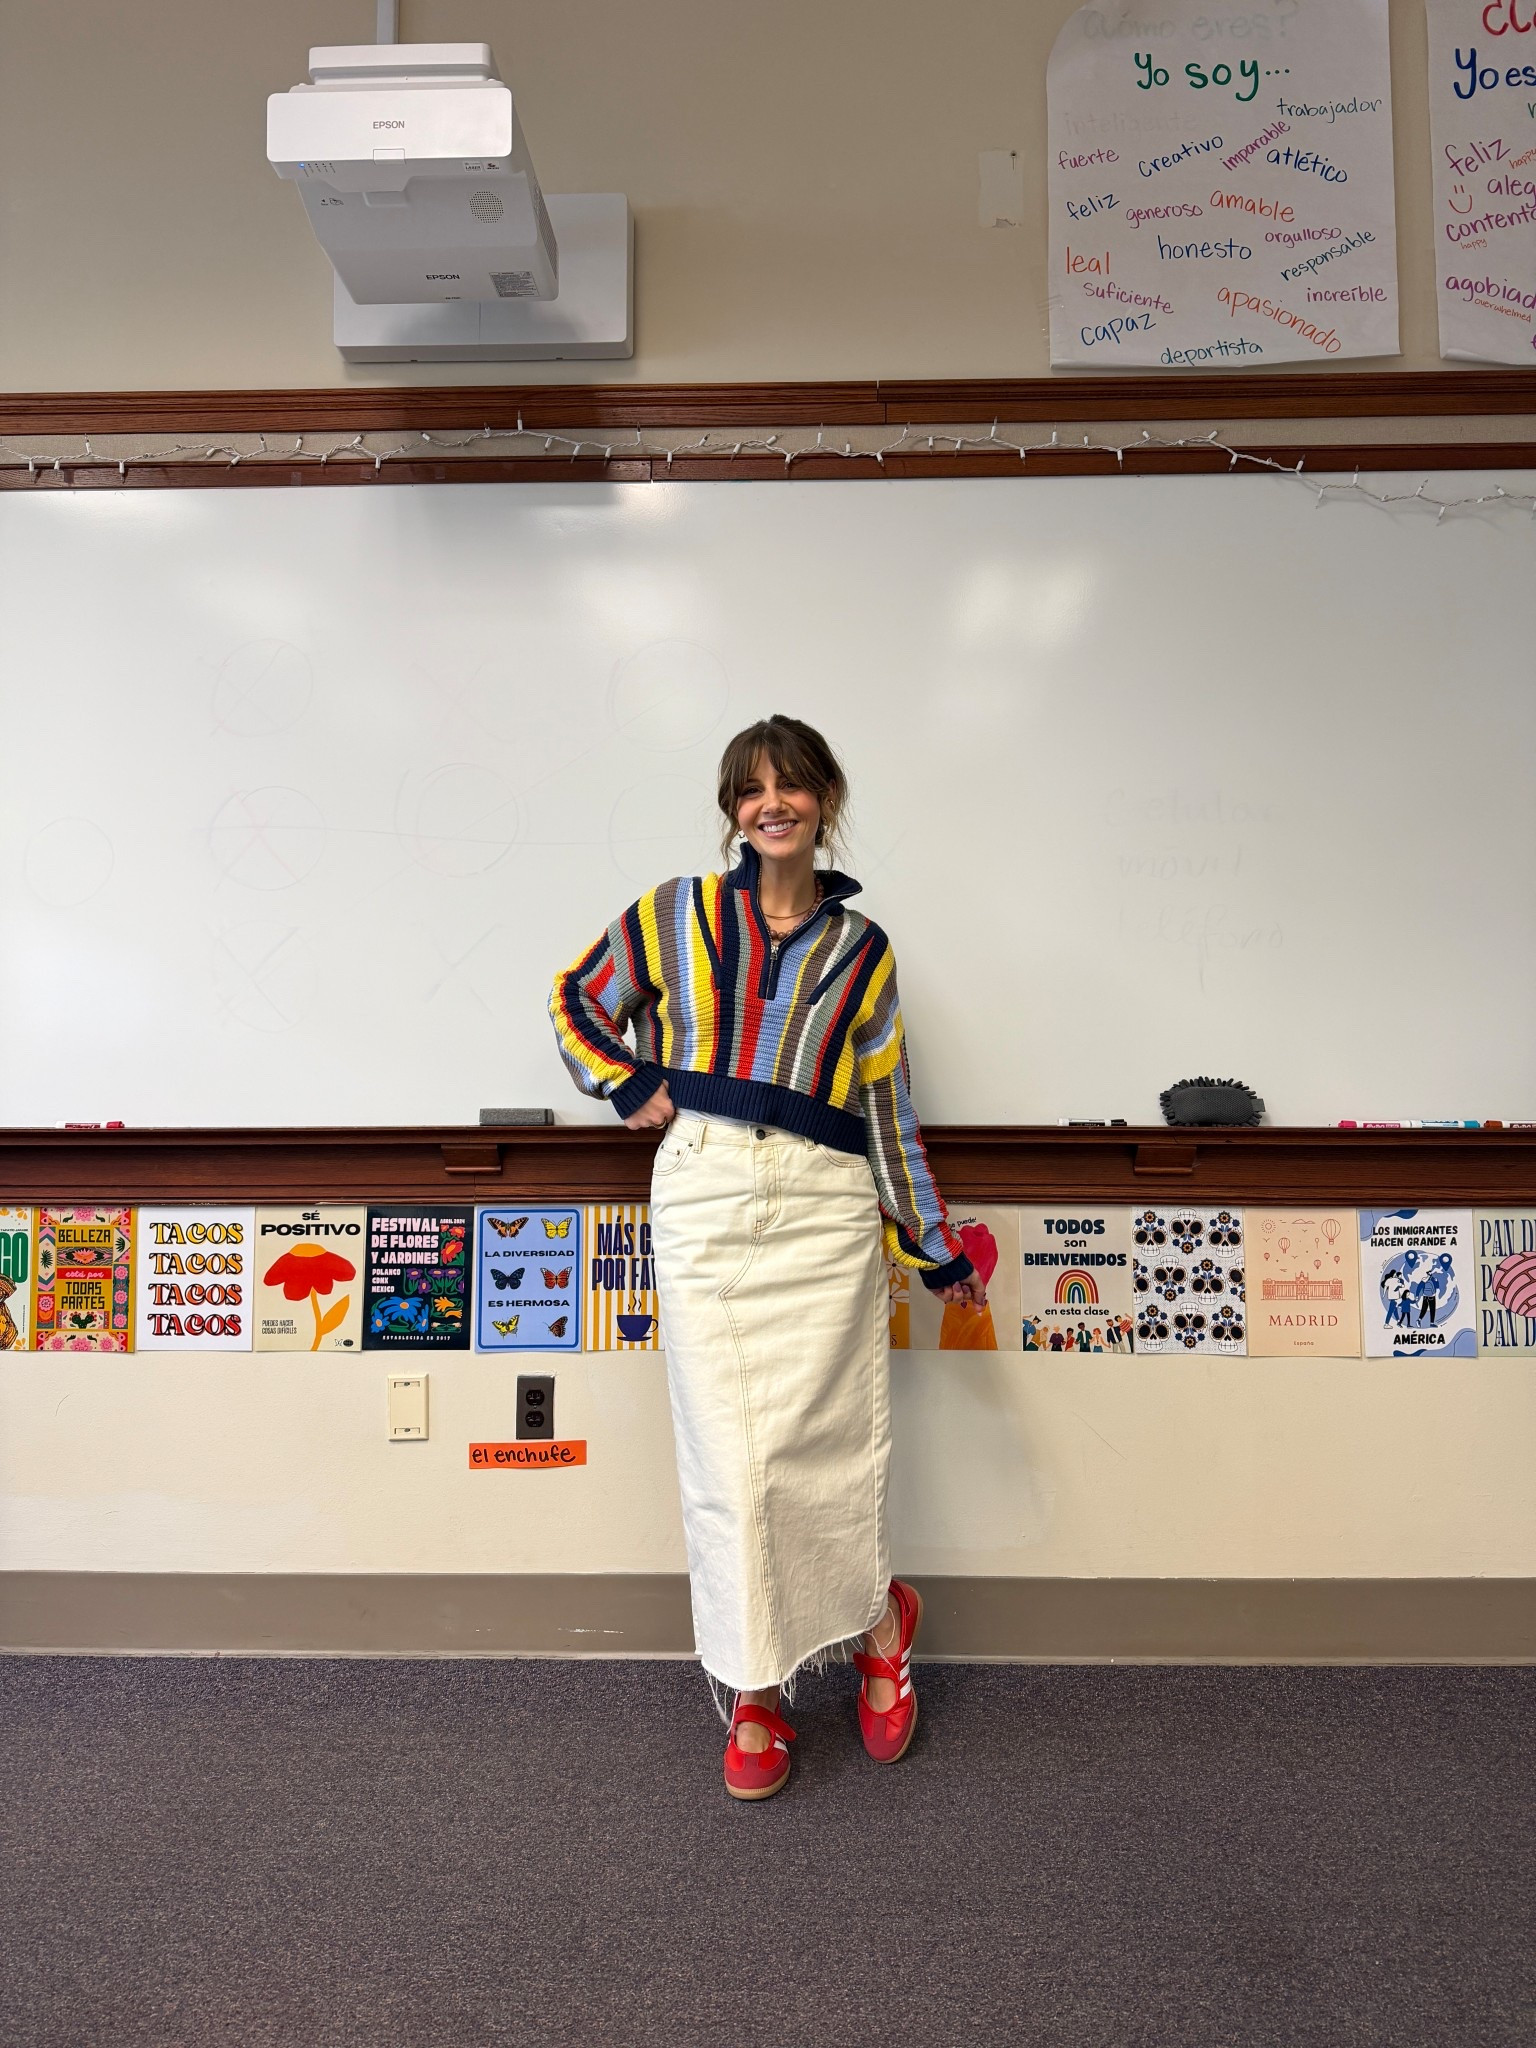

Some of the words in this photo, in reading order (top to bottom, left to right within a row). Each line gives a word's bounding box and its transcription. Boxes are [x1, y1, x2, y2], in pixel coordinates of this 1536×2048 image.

[1134, 52, 1170, 90] Yo
[1454, 48, 1499, 99] Yo
[1276, 97, 1382, 124] trabajador
[372, 120, 405, 130] EPSON
[1219, 120, 1291, 171] imparable
[1058, 148, 1120, 170] fuerte
[1266, 146, 1348, 183] atlético
[1445, 138, 1511, 177] feliz
[1066, 193, 1121, 221] feliz
[1125, 203, 1203, 229] generoso
[1209, 190, 1296, 223] amable
[1157, 235, 1252, 261] honesto
[1264, 226, 1342, 249] orgulloso
[1460, 239, 1488, 250] happy
[1065, 246, 1110, 275] leal
[1280, 229, 1376, 281] responsable
[1306, 285, 1388, 303] increíble
[1217, 286, 1342, 354] apasionado
[1474, 298, 1532, 323] overwhelmed
[1081, 313, 1157, 346] capaz
[1160, 337, 1263, 366] deportista
[302, 1210, 320, 1221] SÉ
[371, 1217, 440, 1232] FESTIVAL
[1043, 1218, 1105, 1235] TODOS
[58, 1229, 111, 1243] BELLEZA
[149, 1222, 244, 1245] TACOS
[260, 1223, 361, 1236] POSITIVO
[597, 1215, 635, 1256] MÁS
[639, 1223, 654, 1256] C
[1372, 1226, 1390, 1236] LOS
[1393, 1225, 1459, 1236] INMIGRANTES
[1480, 1219, 1515, 1257] PAN
[1521, 1219, 1536, 1252] D
[371, 1234, 388, 1249] DE
[390, 1234, 439, 1249] FLORES
[1064, 1239, 1087, 1248] son
[1370, 1237, 1404, 1247] HACEN
[1407, 1237, 1447, 1247] GRANDE
[1450, 1236, 1458, 1246] A
[149, 1252, 243, 1275] TACOS
[371, 1251, 379, 1265] Y
[380, 1251, 439, 1265] JARDINES
[484, 1250, 500, 1258] LA
[503, 1250, 575, 1258] DIVERSIDAD
[1024, 1252, 1127, 1267] BIENVENIDOS
[371, 1268, 401, 1276] POLANCO
[591, 1257, 626, 1291] POR
[65, 1281, 102, 1295] TODAS
[148, 1283, 243, 1306] TACOS
[61, 1296, 105, 1309] PARTES
[506, 1299, 570, 1307] HERMOSA
[1060, 1308, 1080, 1316] esta
[1084, 1306, 1110, 1315] clase
[147, 1313, 242, 1336] TACOS
[1268, 1314, 1338, 1327] MADRID
[1482, 1309, 1518, 1347] PAN
[1393, 1331, 1445, 1344] AMÉRICA
[472, 1448, 488, 1463] el
[494, 1444, 576, 1463] enchufe
